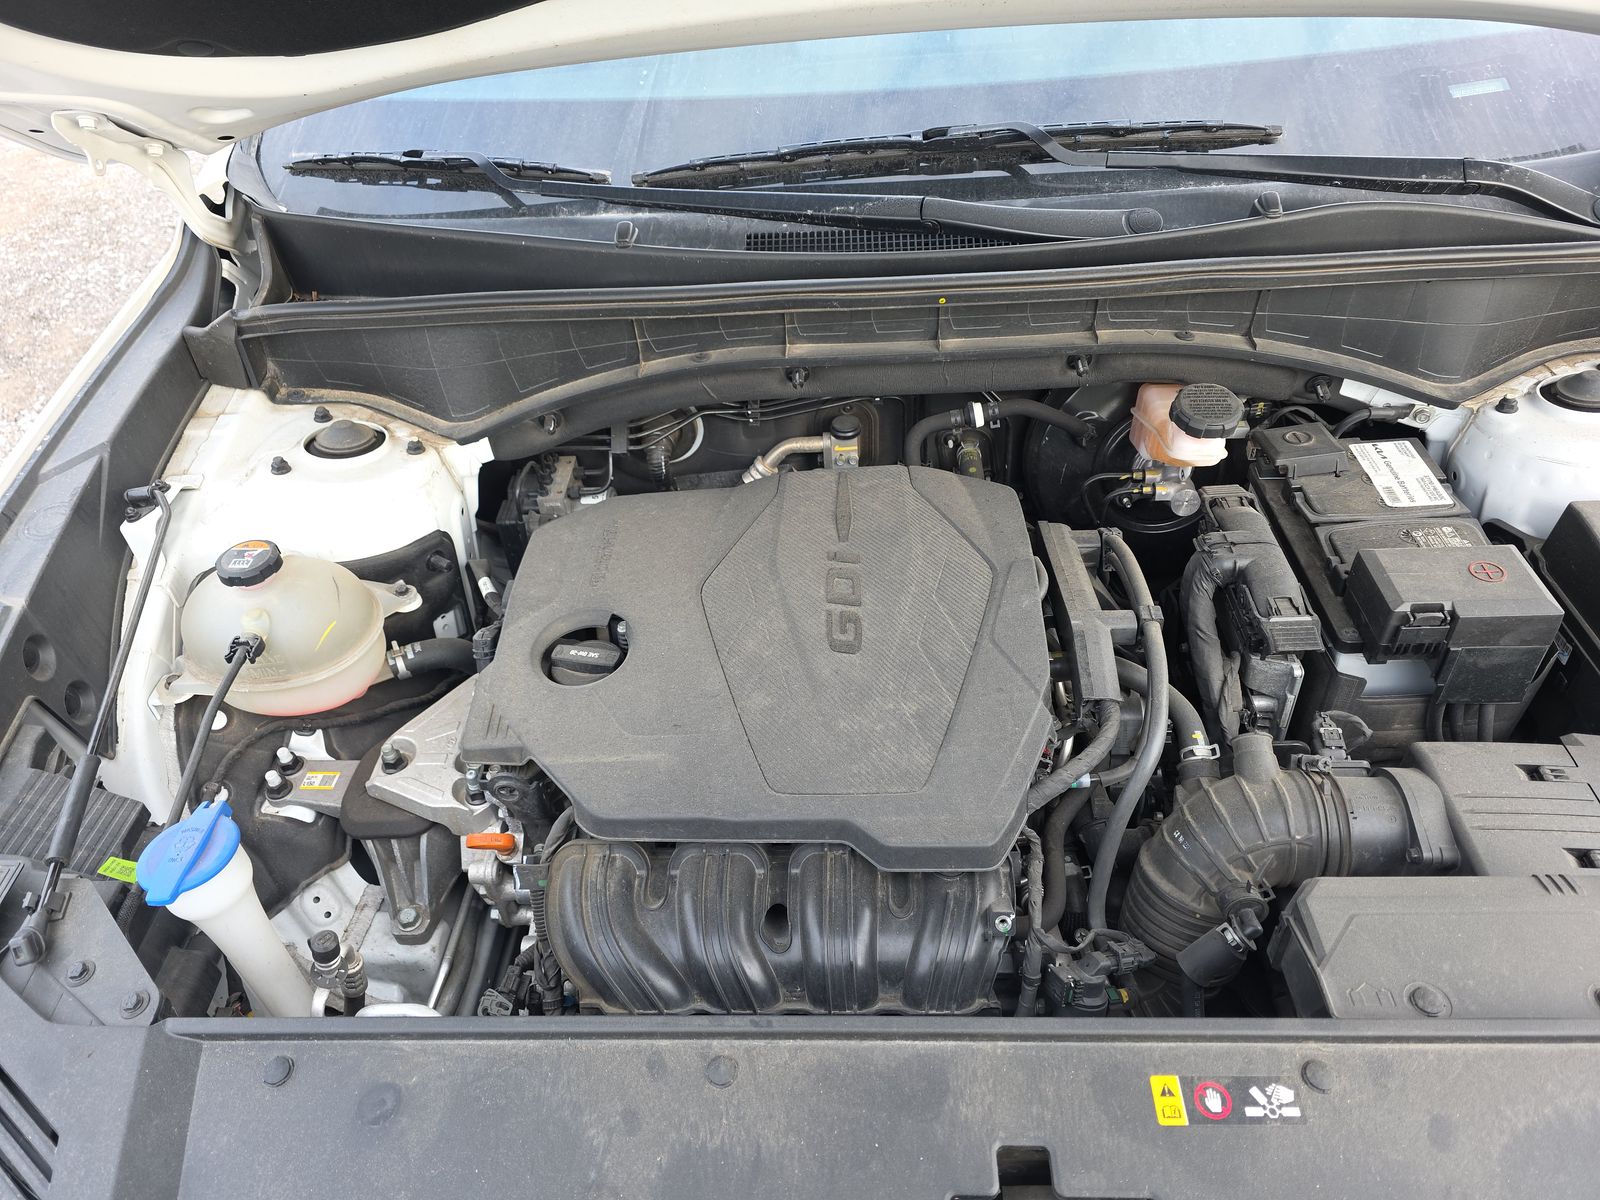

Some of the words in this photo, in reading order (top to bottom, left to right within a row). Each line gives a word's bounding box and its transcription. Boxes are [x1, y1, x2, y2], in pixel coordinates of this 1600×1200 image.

[1371, 443, 1388, 460] KIA
[1383, 460, 1401, 484] Genuine
[1398, 480, 1417, 503] Batteries
